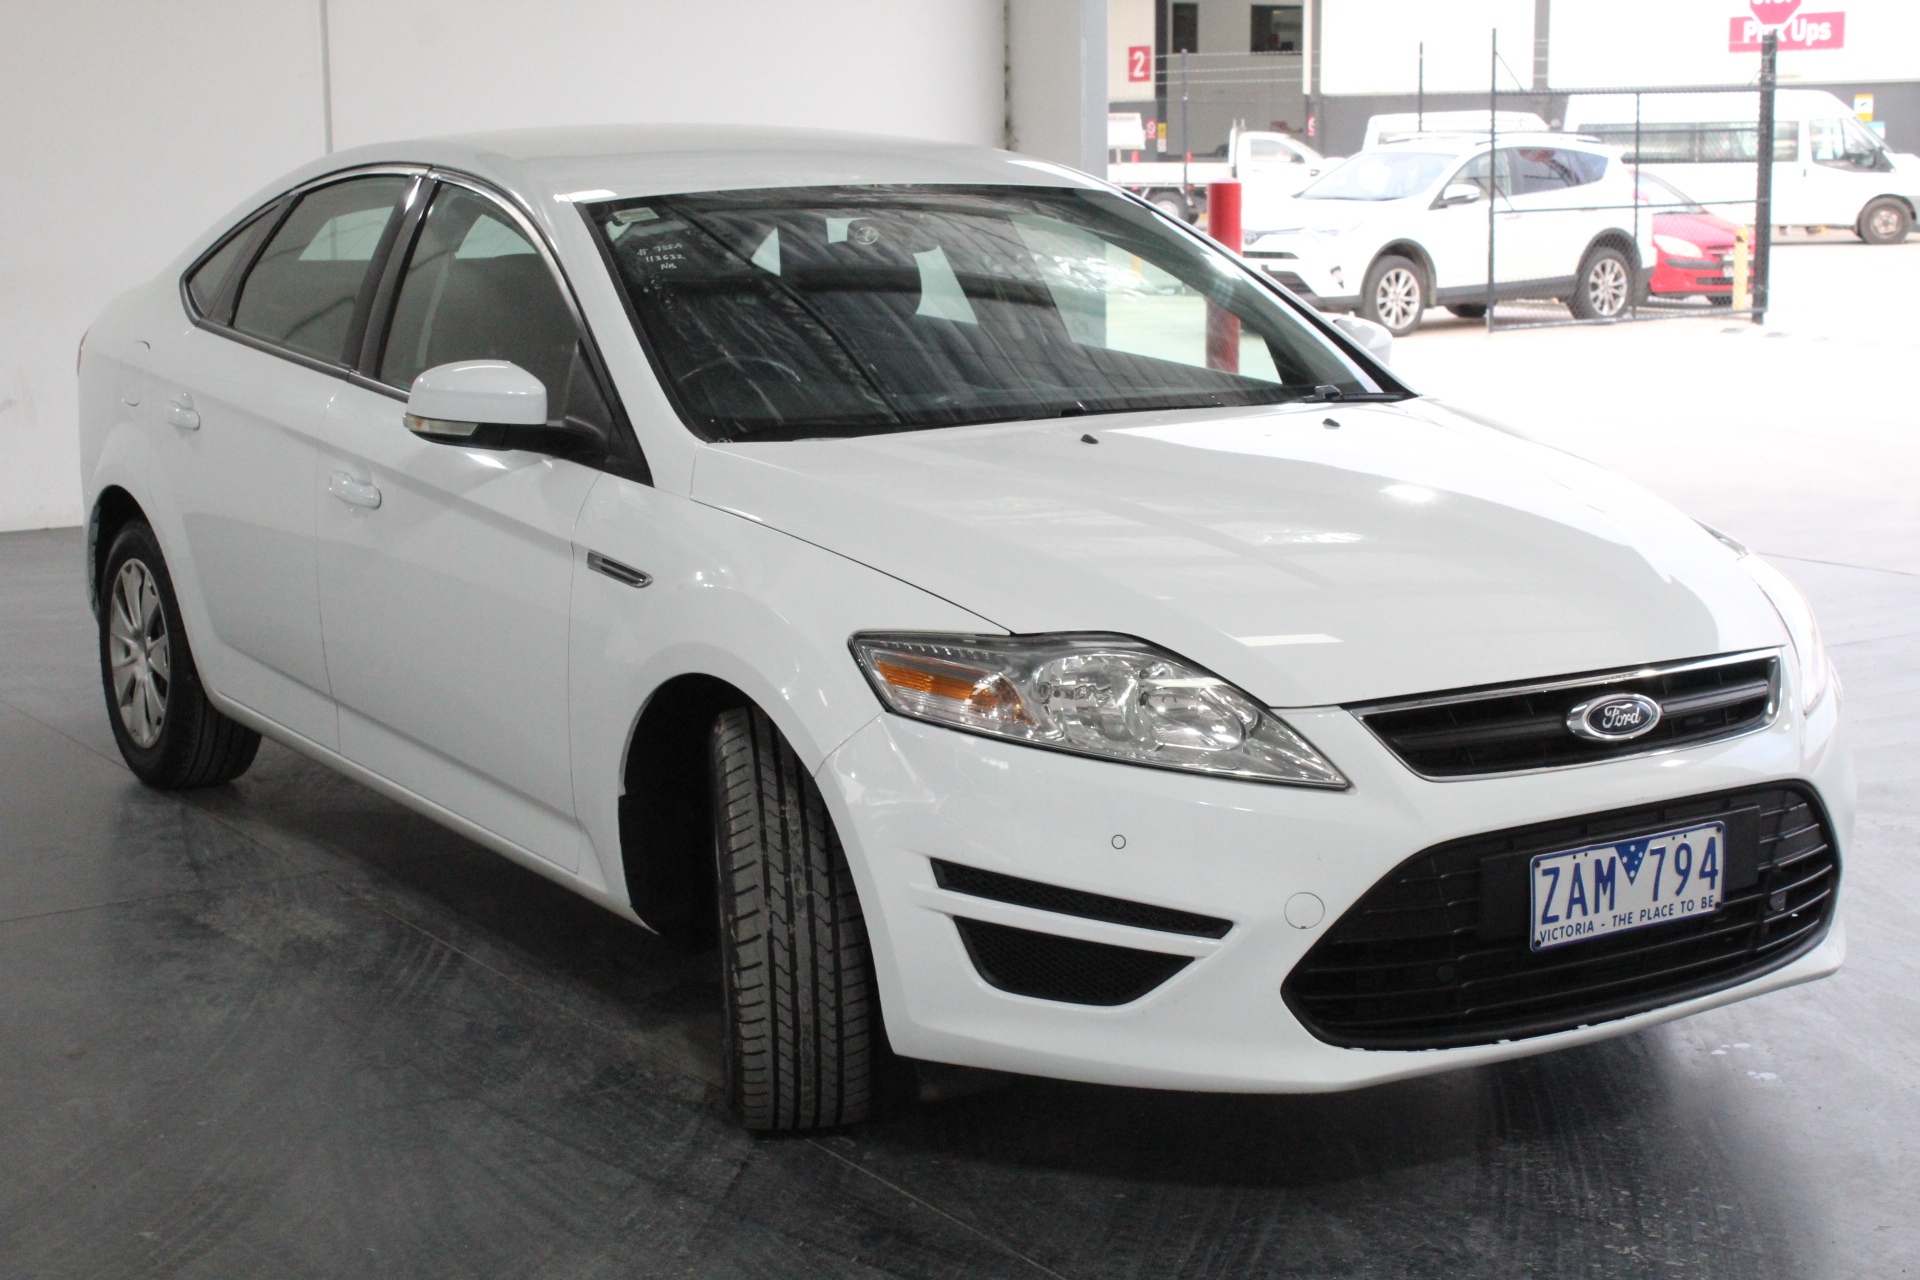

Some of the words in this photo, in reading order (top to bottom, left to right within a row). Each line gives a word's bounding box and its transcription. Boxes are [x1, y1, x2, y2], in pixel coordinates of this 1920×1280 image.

[1790, 18, 1832, 46] Ups
[1133, 50, 1146, 78] 2
[1602, 703, 1641, 728] Ford
[1541, 855, 1617, 925] ZAM
[1649, 836, 1719, 902] 794
[1540, 920, 1594, 943] VICTORIA
[1612, 911, 1633, 927] THE
[1639, 903, 1674, 922] PLACE
[1680, 899, 1695, 913] TO
[1701, 895, 1714, 910] BE
